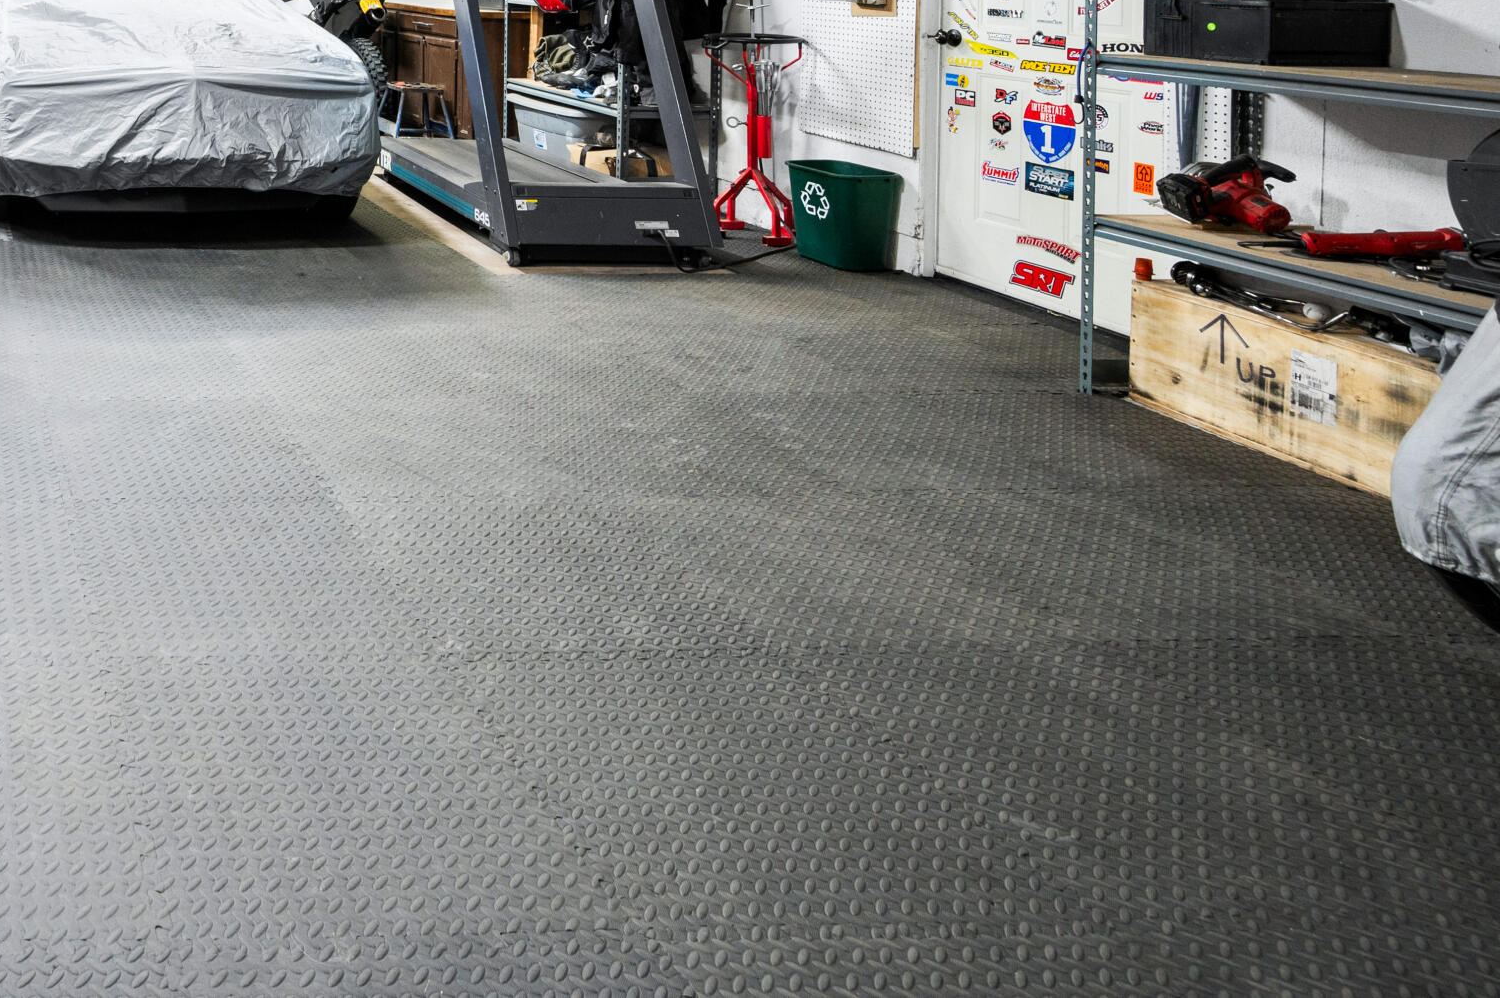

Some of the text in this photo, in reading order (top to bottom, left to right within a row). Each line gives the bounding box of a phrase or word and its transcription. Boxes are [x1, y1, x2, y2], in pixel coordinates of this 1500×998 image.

[1102, 42, 1144, 53] HON
[1020, 60, 1077, 75] RACE TECH
[1031, 102, 1067, 116] INTERSTATE
[1040, 112, 1056, 123] WEST
[1040, 124, 1055, 155] 1
[1032, 165, 1070, 178] SUPER
[1029, 172, 1068, 187] START
[1029, 182, 1060, 193] PLATINUM
[474, 208, 491, 227] 645
[1010, 260, 1075, 298] SRT
